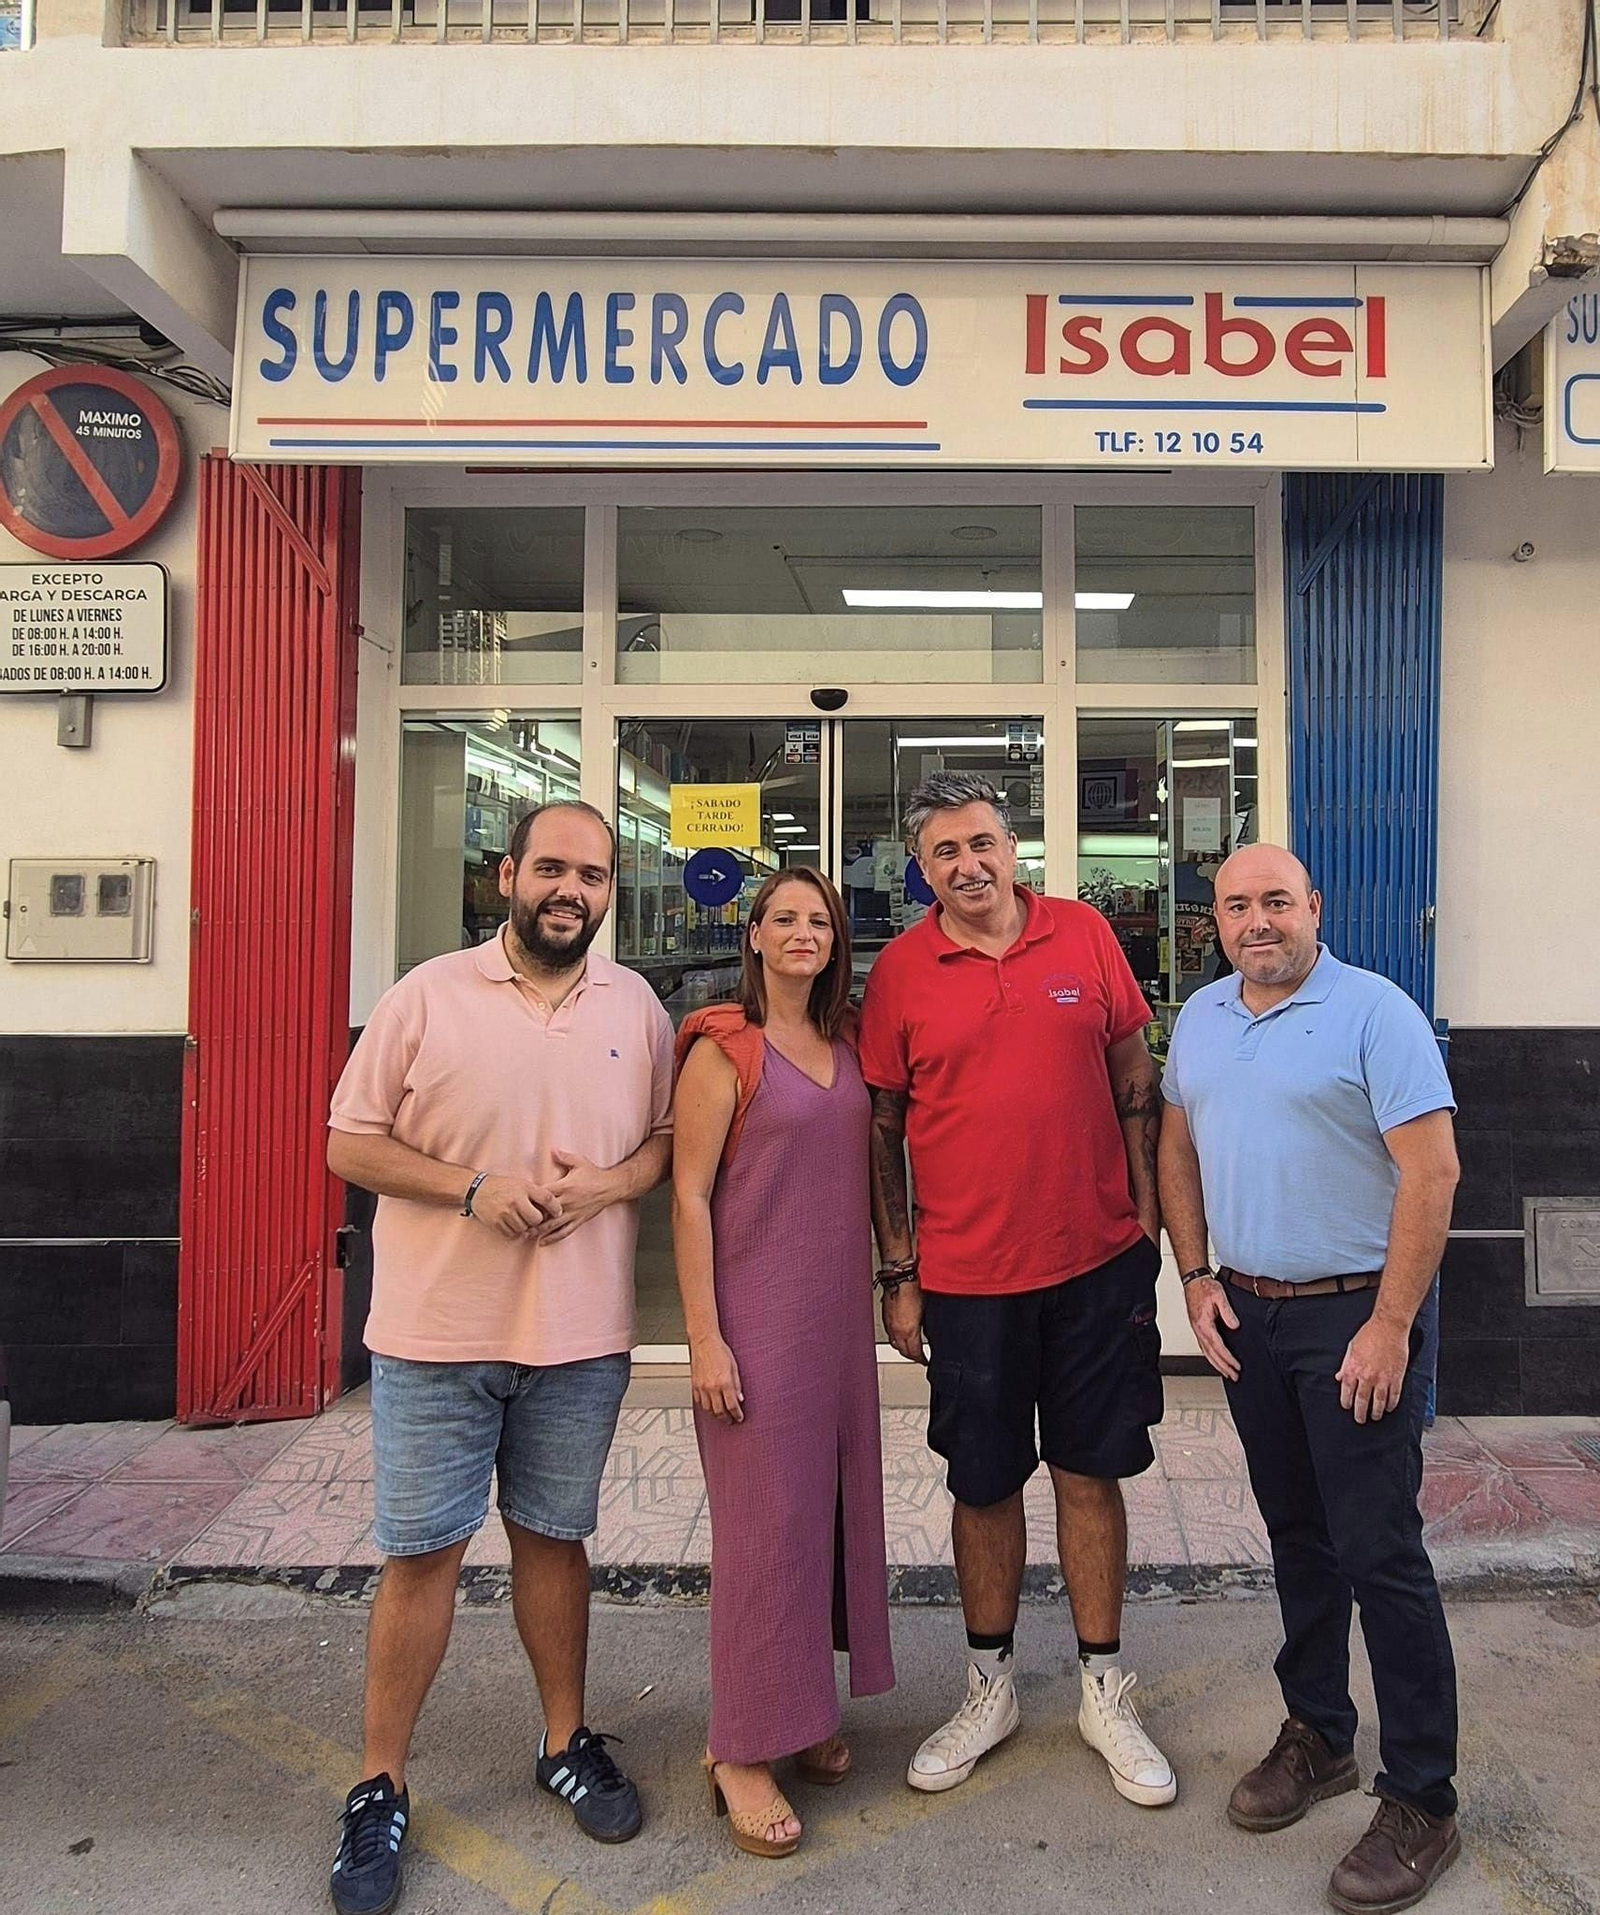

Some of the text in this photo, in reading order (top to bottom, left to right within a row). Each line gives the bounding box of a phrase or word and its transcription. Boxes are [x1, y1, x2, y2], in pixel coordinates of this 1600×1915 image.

[259, 287, 928, 388] SUPERMERCADO
[1025, 292, 1387, 378] Isabel
[79, 410, 141, 427] MAXIMO
[75, 425, 142, 439] 45 MINUTOS
[1094, 431, 1264, 454] TLF: 12 10 54
[32, 573, 103, 585] EXCEPTO
[47, 590, 57, 601] Y
[62, 589, 147, 601] DESCARGA
[13, 608, 122, 622] DE LUNES A VIERNES
[12, 627, 124, 640] DE 08:00 H. A 14:00 H.
[12, 644, 124, 656] DE 16:00 H. A 20:00 H.
[34, 667, 47, 680] DE
[50, 667, 81, 680] 08:00
[84, 667, 95, 680] H.
[98, 667, 105, 680] A
[109, 667, 139, 680] 14:00
[141, 667, 152, 680] H.
[697, 811, 734, 820] TARDE
[687, 824, 744, 833] CERRADO!
